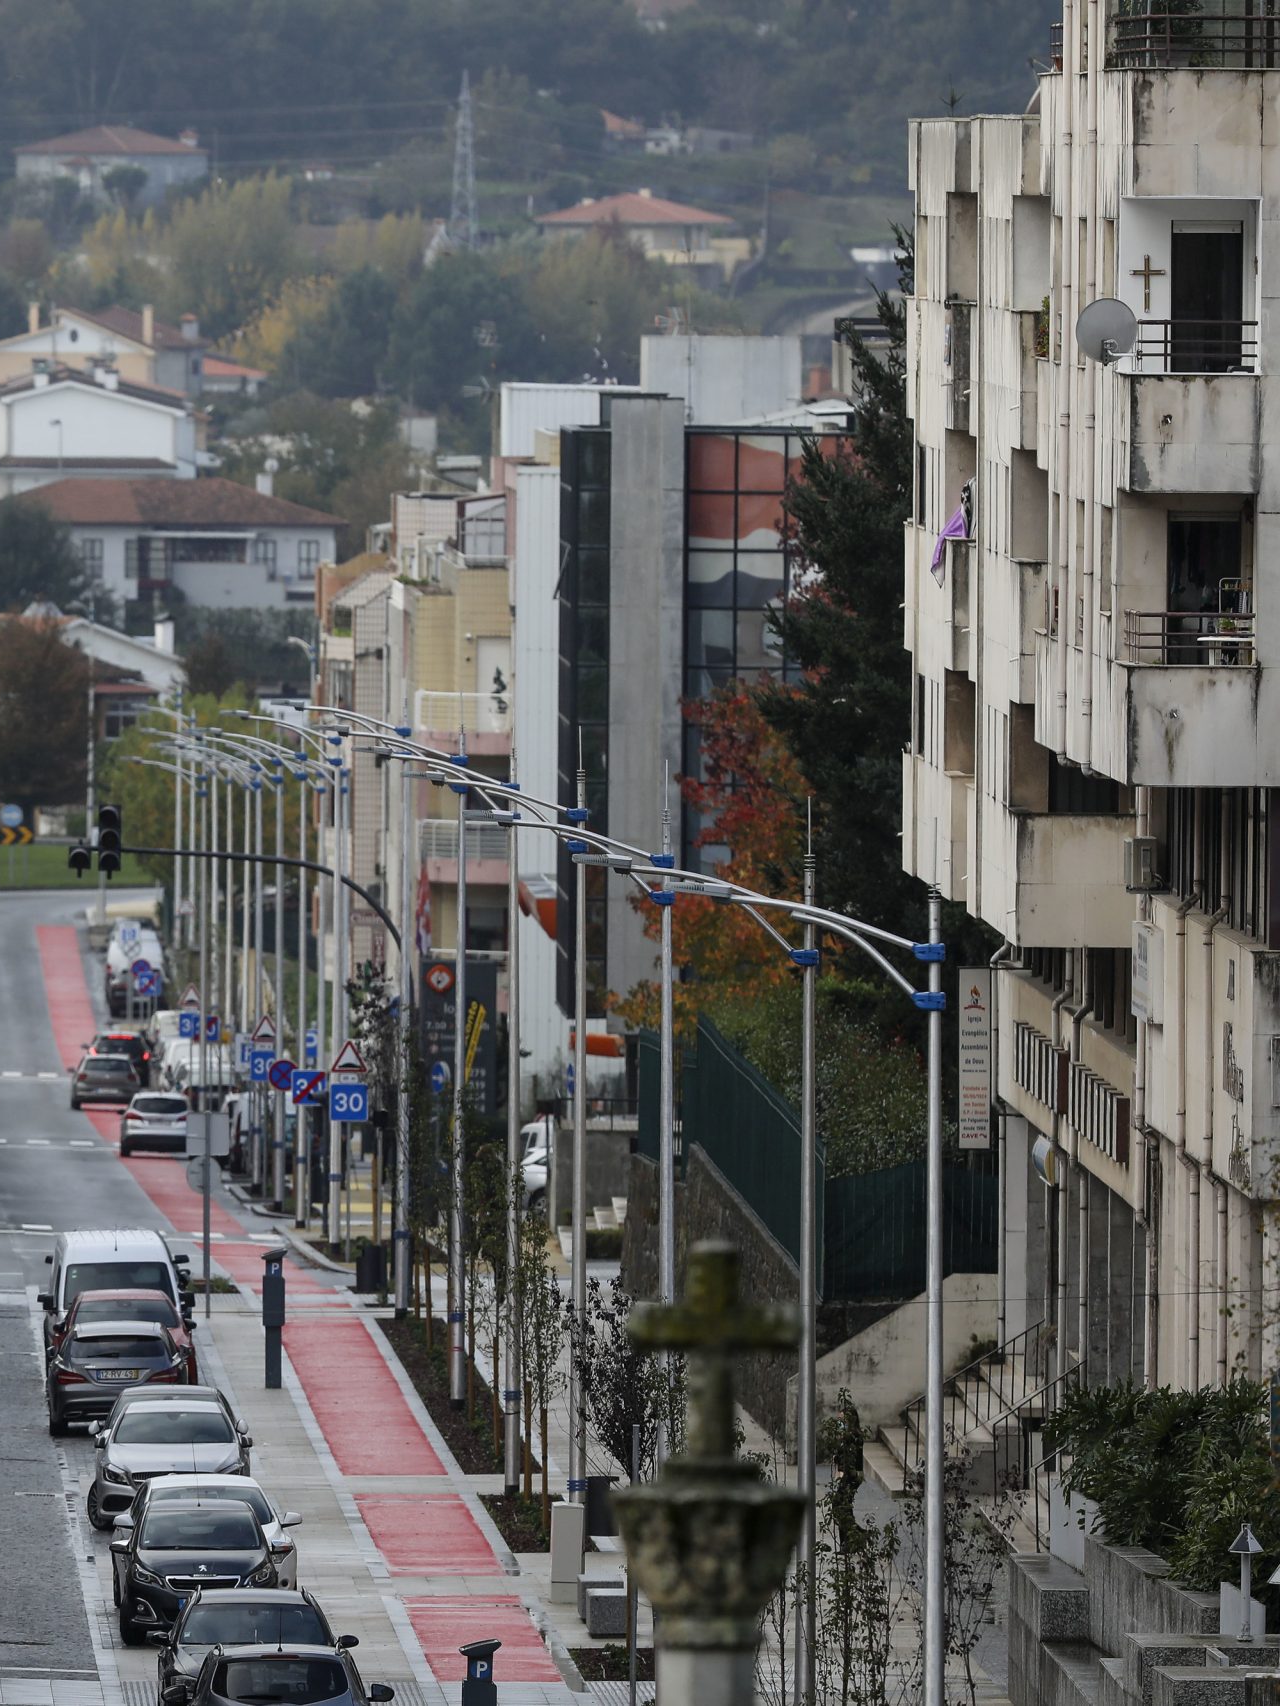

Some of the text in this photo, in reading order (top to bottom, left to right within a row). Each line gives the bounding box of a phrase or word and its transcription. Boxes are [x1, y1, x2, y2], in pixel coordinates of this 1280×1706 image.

[967, 1015, 982, 1024] Igreja
[334, 1092, 364, 1112] 30
[271, 1262, 279, 1275] P
[476, 1661, 488, 1678] P
